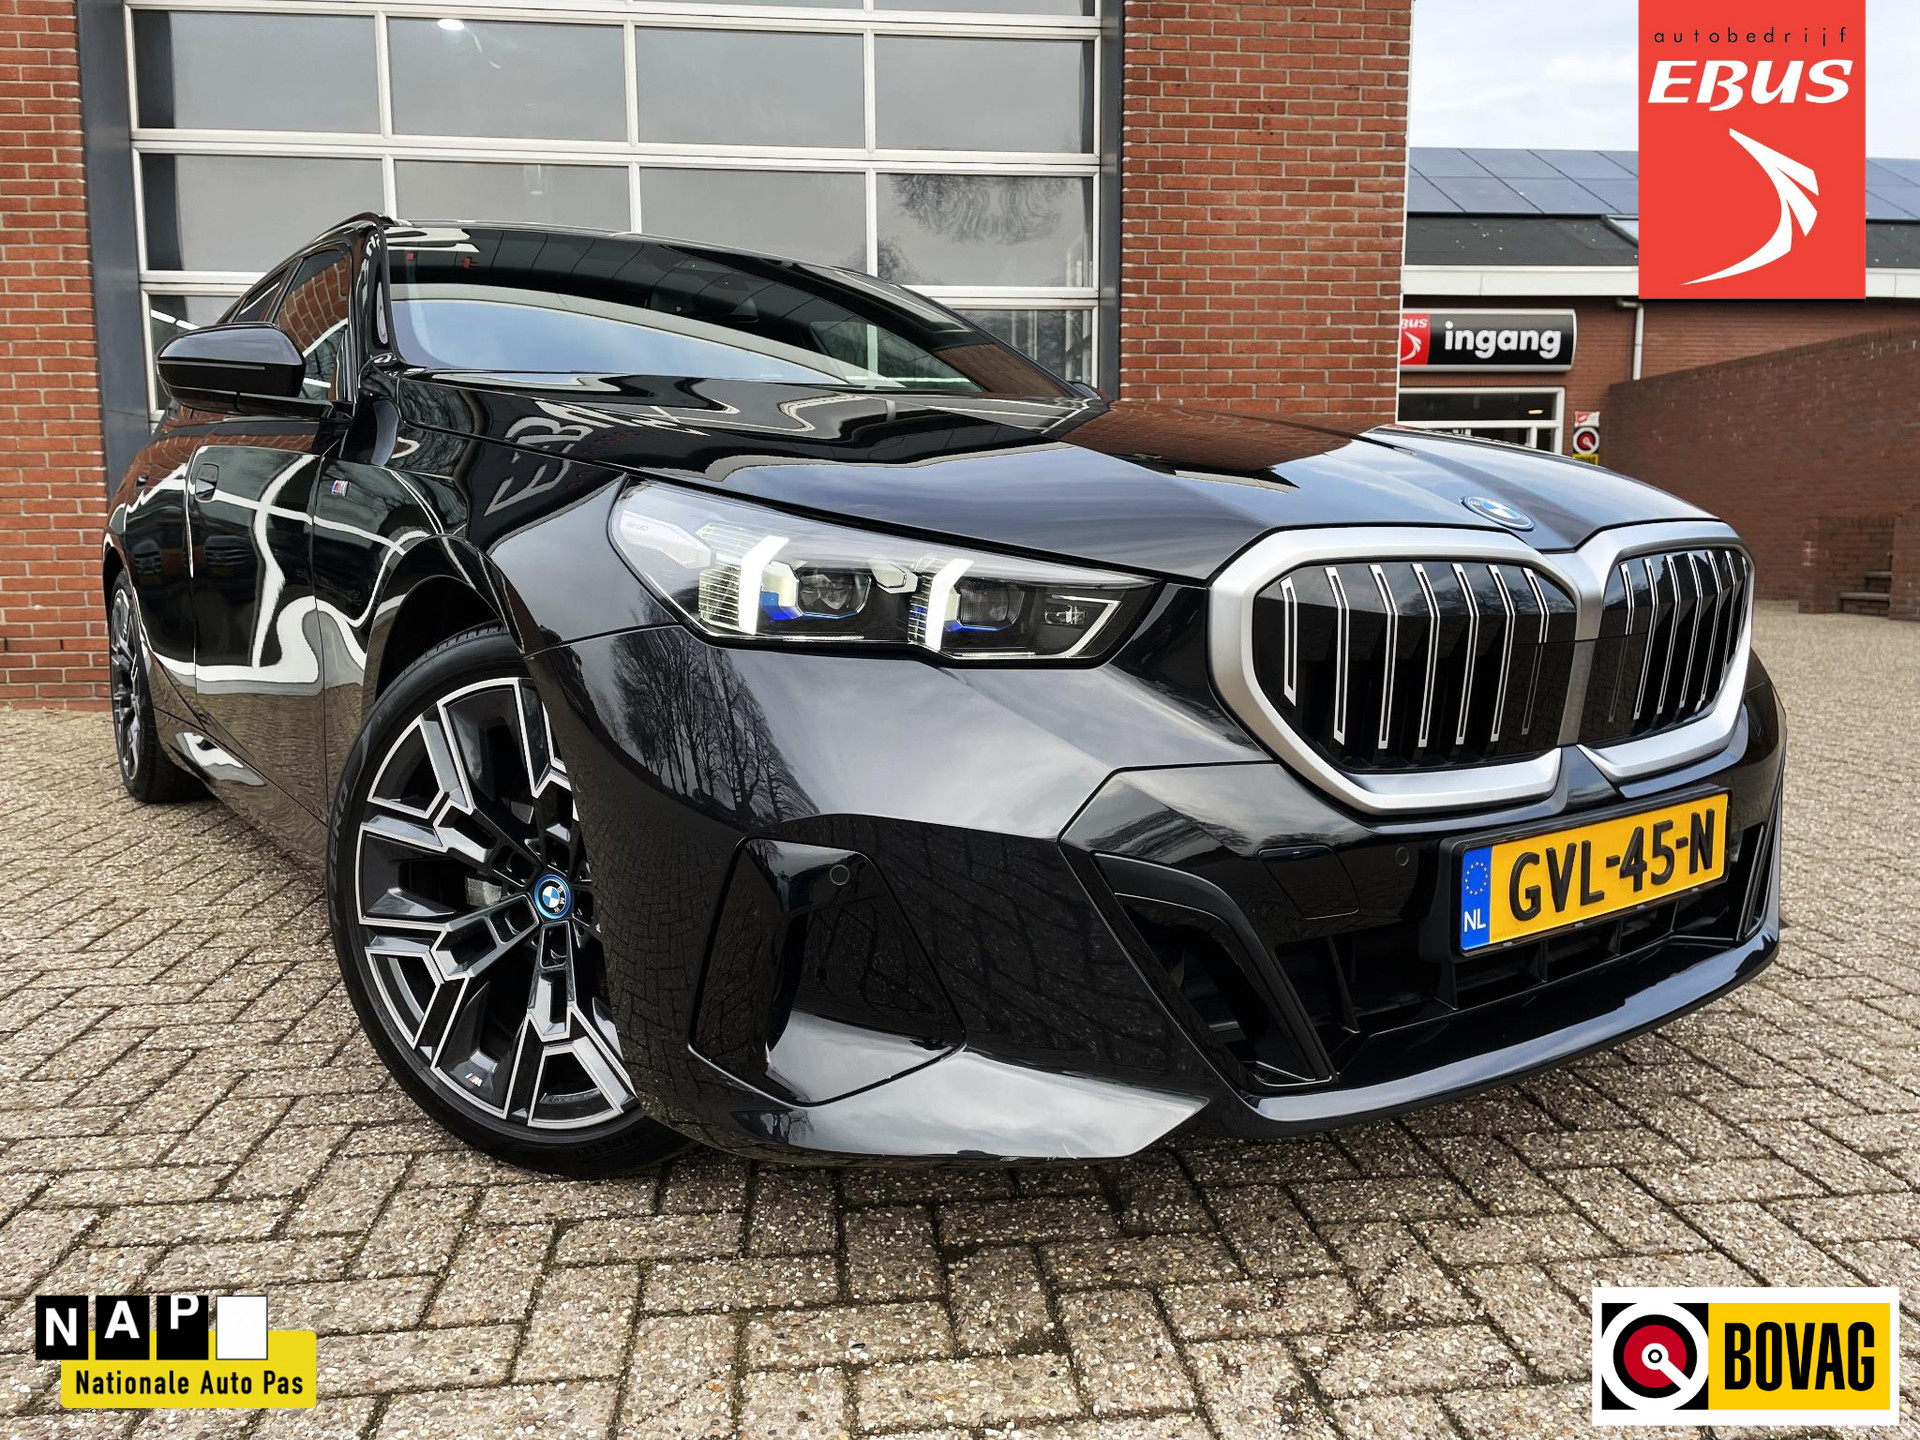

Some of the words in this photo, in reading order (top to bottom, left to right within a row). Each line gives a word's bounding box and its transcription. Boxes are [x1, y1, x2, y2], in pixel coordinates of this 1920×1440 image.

[1444, 320, 1562, 360] ingang
[1509, 808, 1715, 922] GVL-45-N
[1464, 908, 1487, 933] NL
